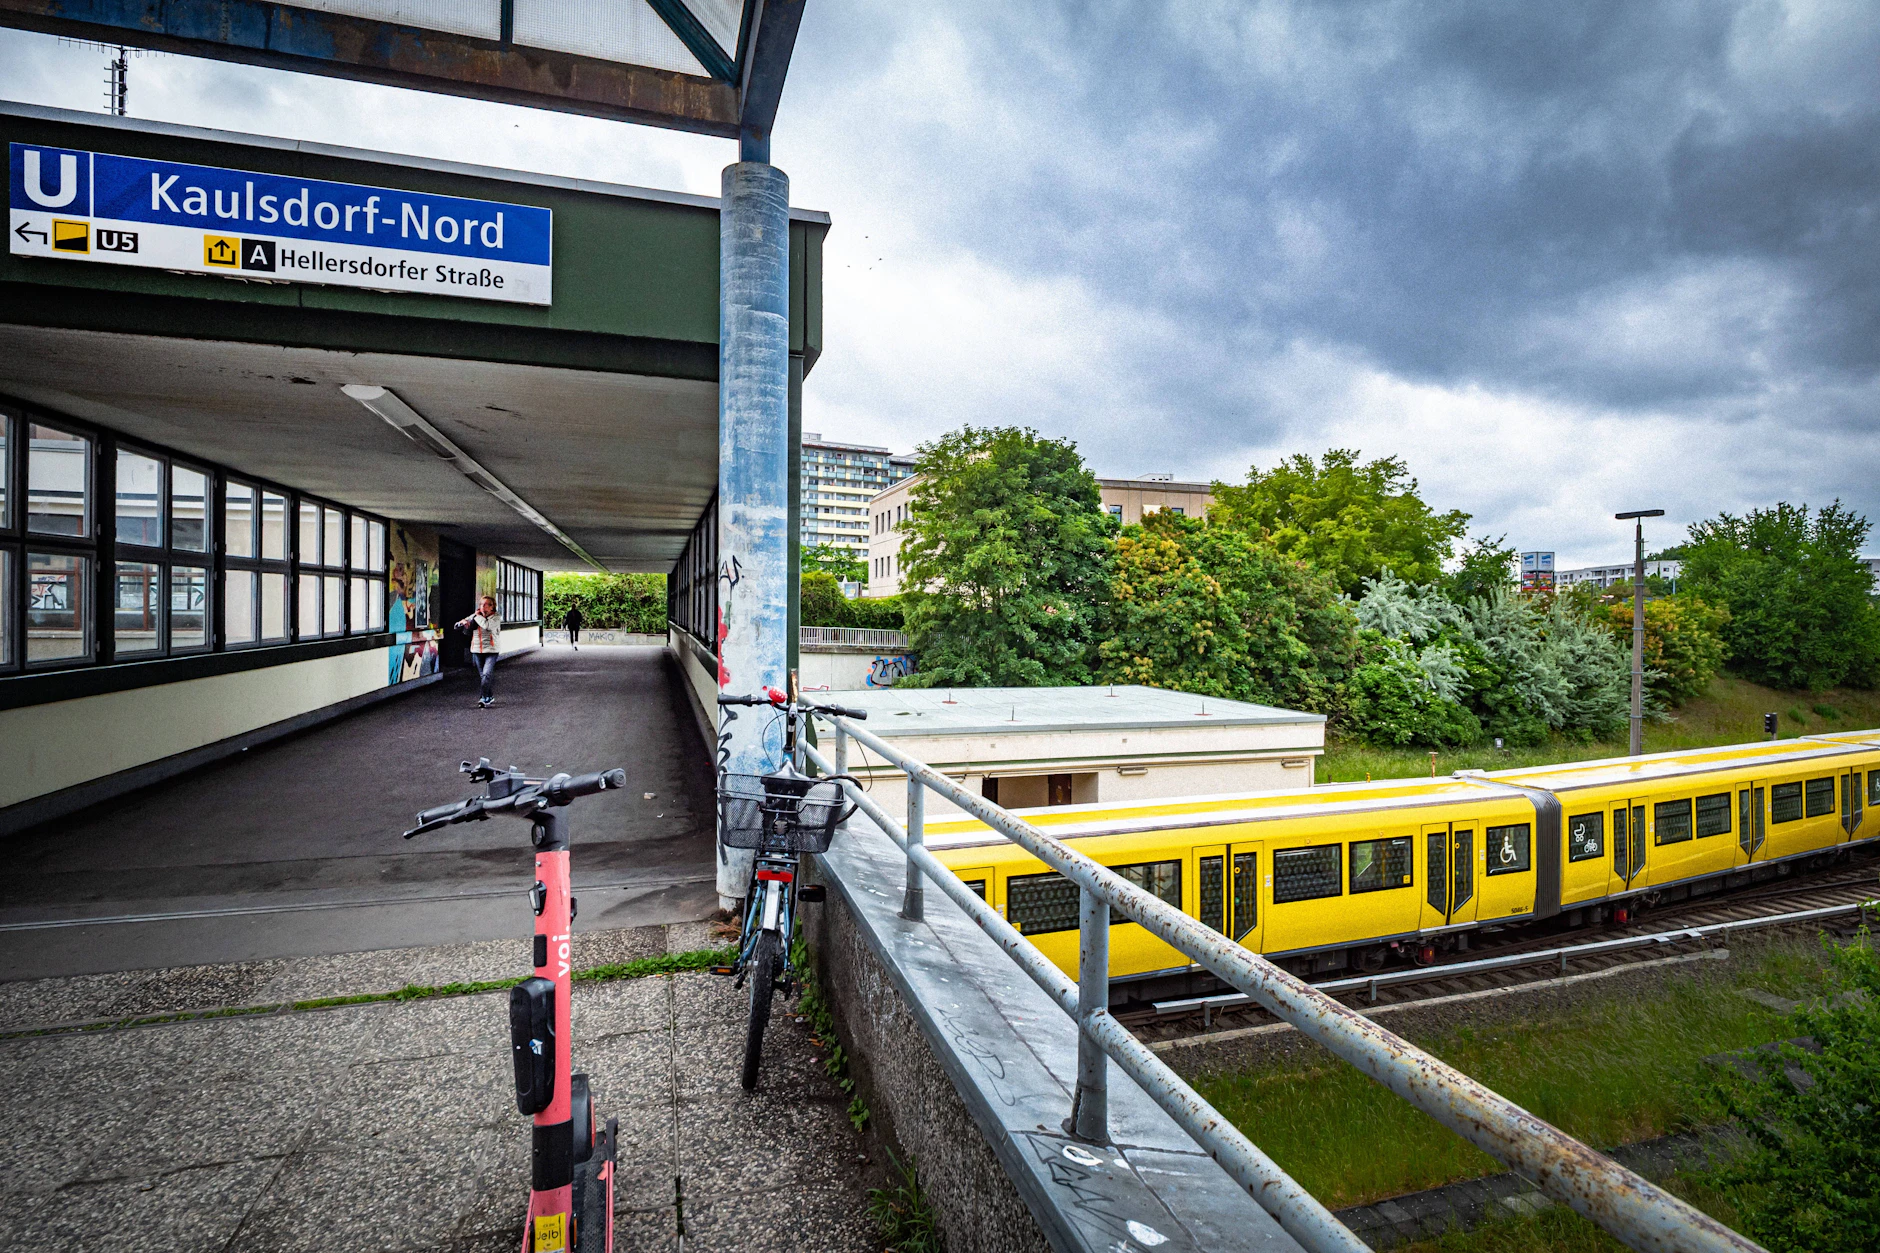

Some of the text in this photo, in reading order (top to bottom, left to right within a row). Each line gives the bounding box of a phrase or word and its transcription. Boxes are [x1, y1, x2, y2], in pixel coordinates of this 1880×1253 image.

[24, 149, 77, 208] U
[151, 172, 504, 249] Kaulsdorf-Nord
[101, 231, 135, 251] U5
[249, 244, 504, 289] A Hellersdorfer Straße
